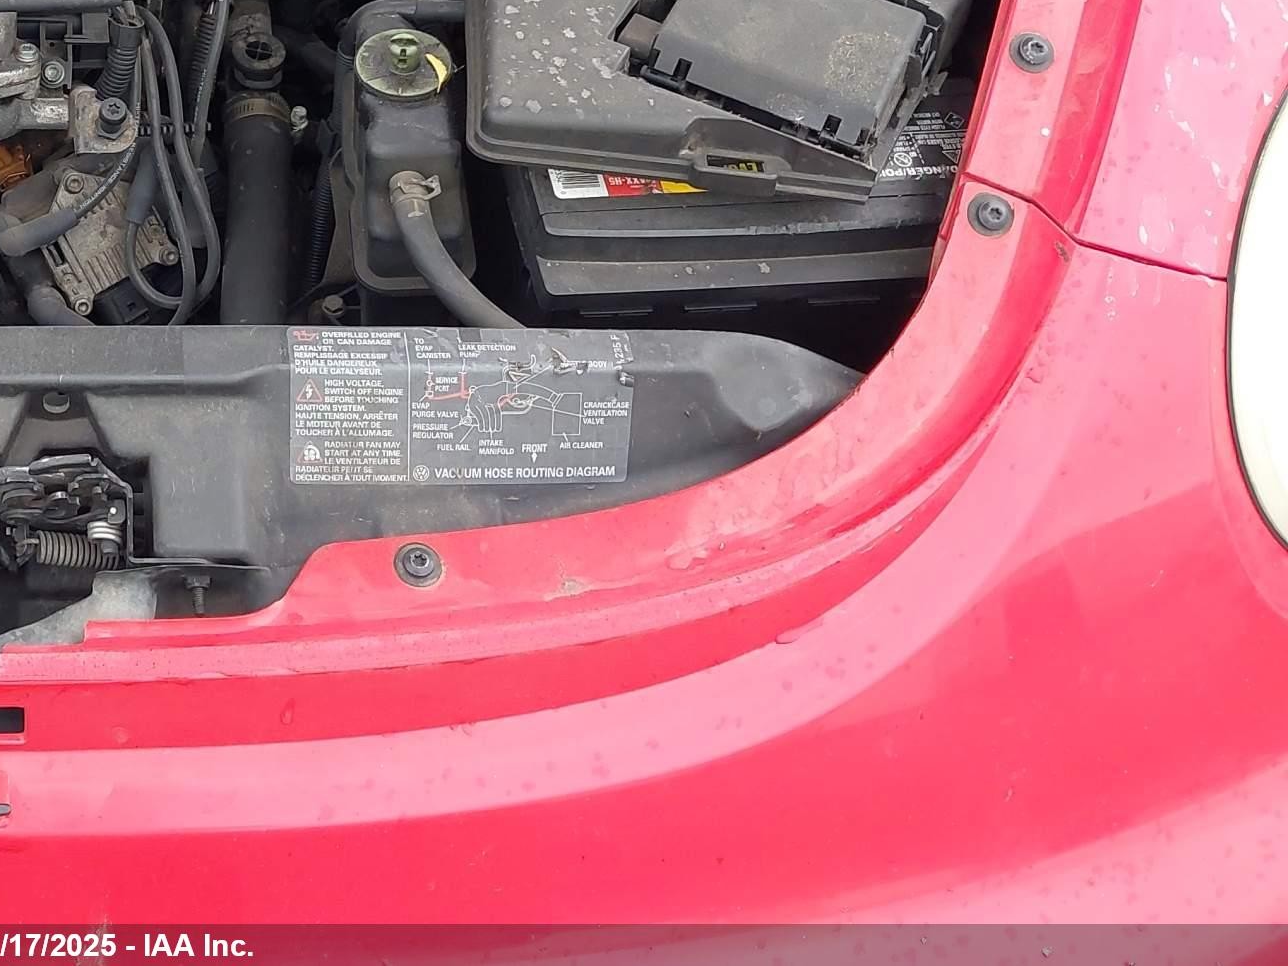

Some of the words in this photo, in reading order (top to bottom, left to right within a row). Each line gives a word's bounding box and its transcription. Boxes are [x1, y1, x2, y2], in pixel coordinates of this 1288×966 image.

[362, 411, 398, 420] ARRÊTER
[522, 444, 548, 452] FRONT
[434, 468, 484, 478] VACUUM
[485, 468, 514, 478] HOSE
[516, 467, 564, 478] ROUTING
[566, 466, 616, 477] DIAGRAM
